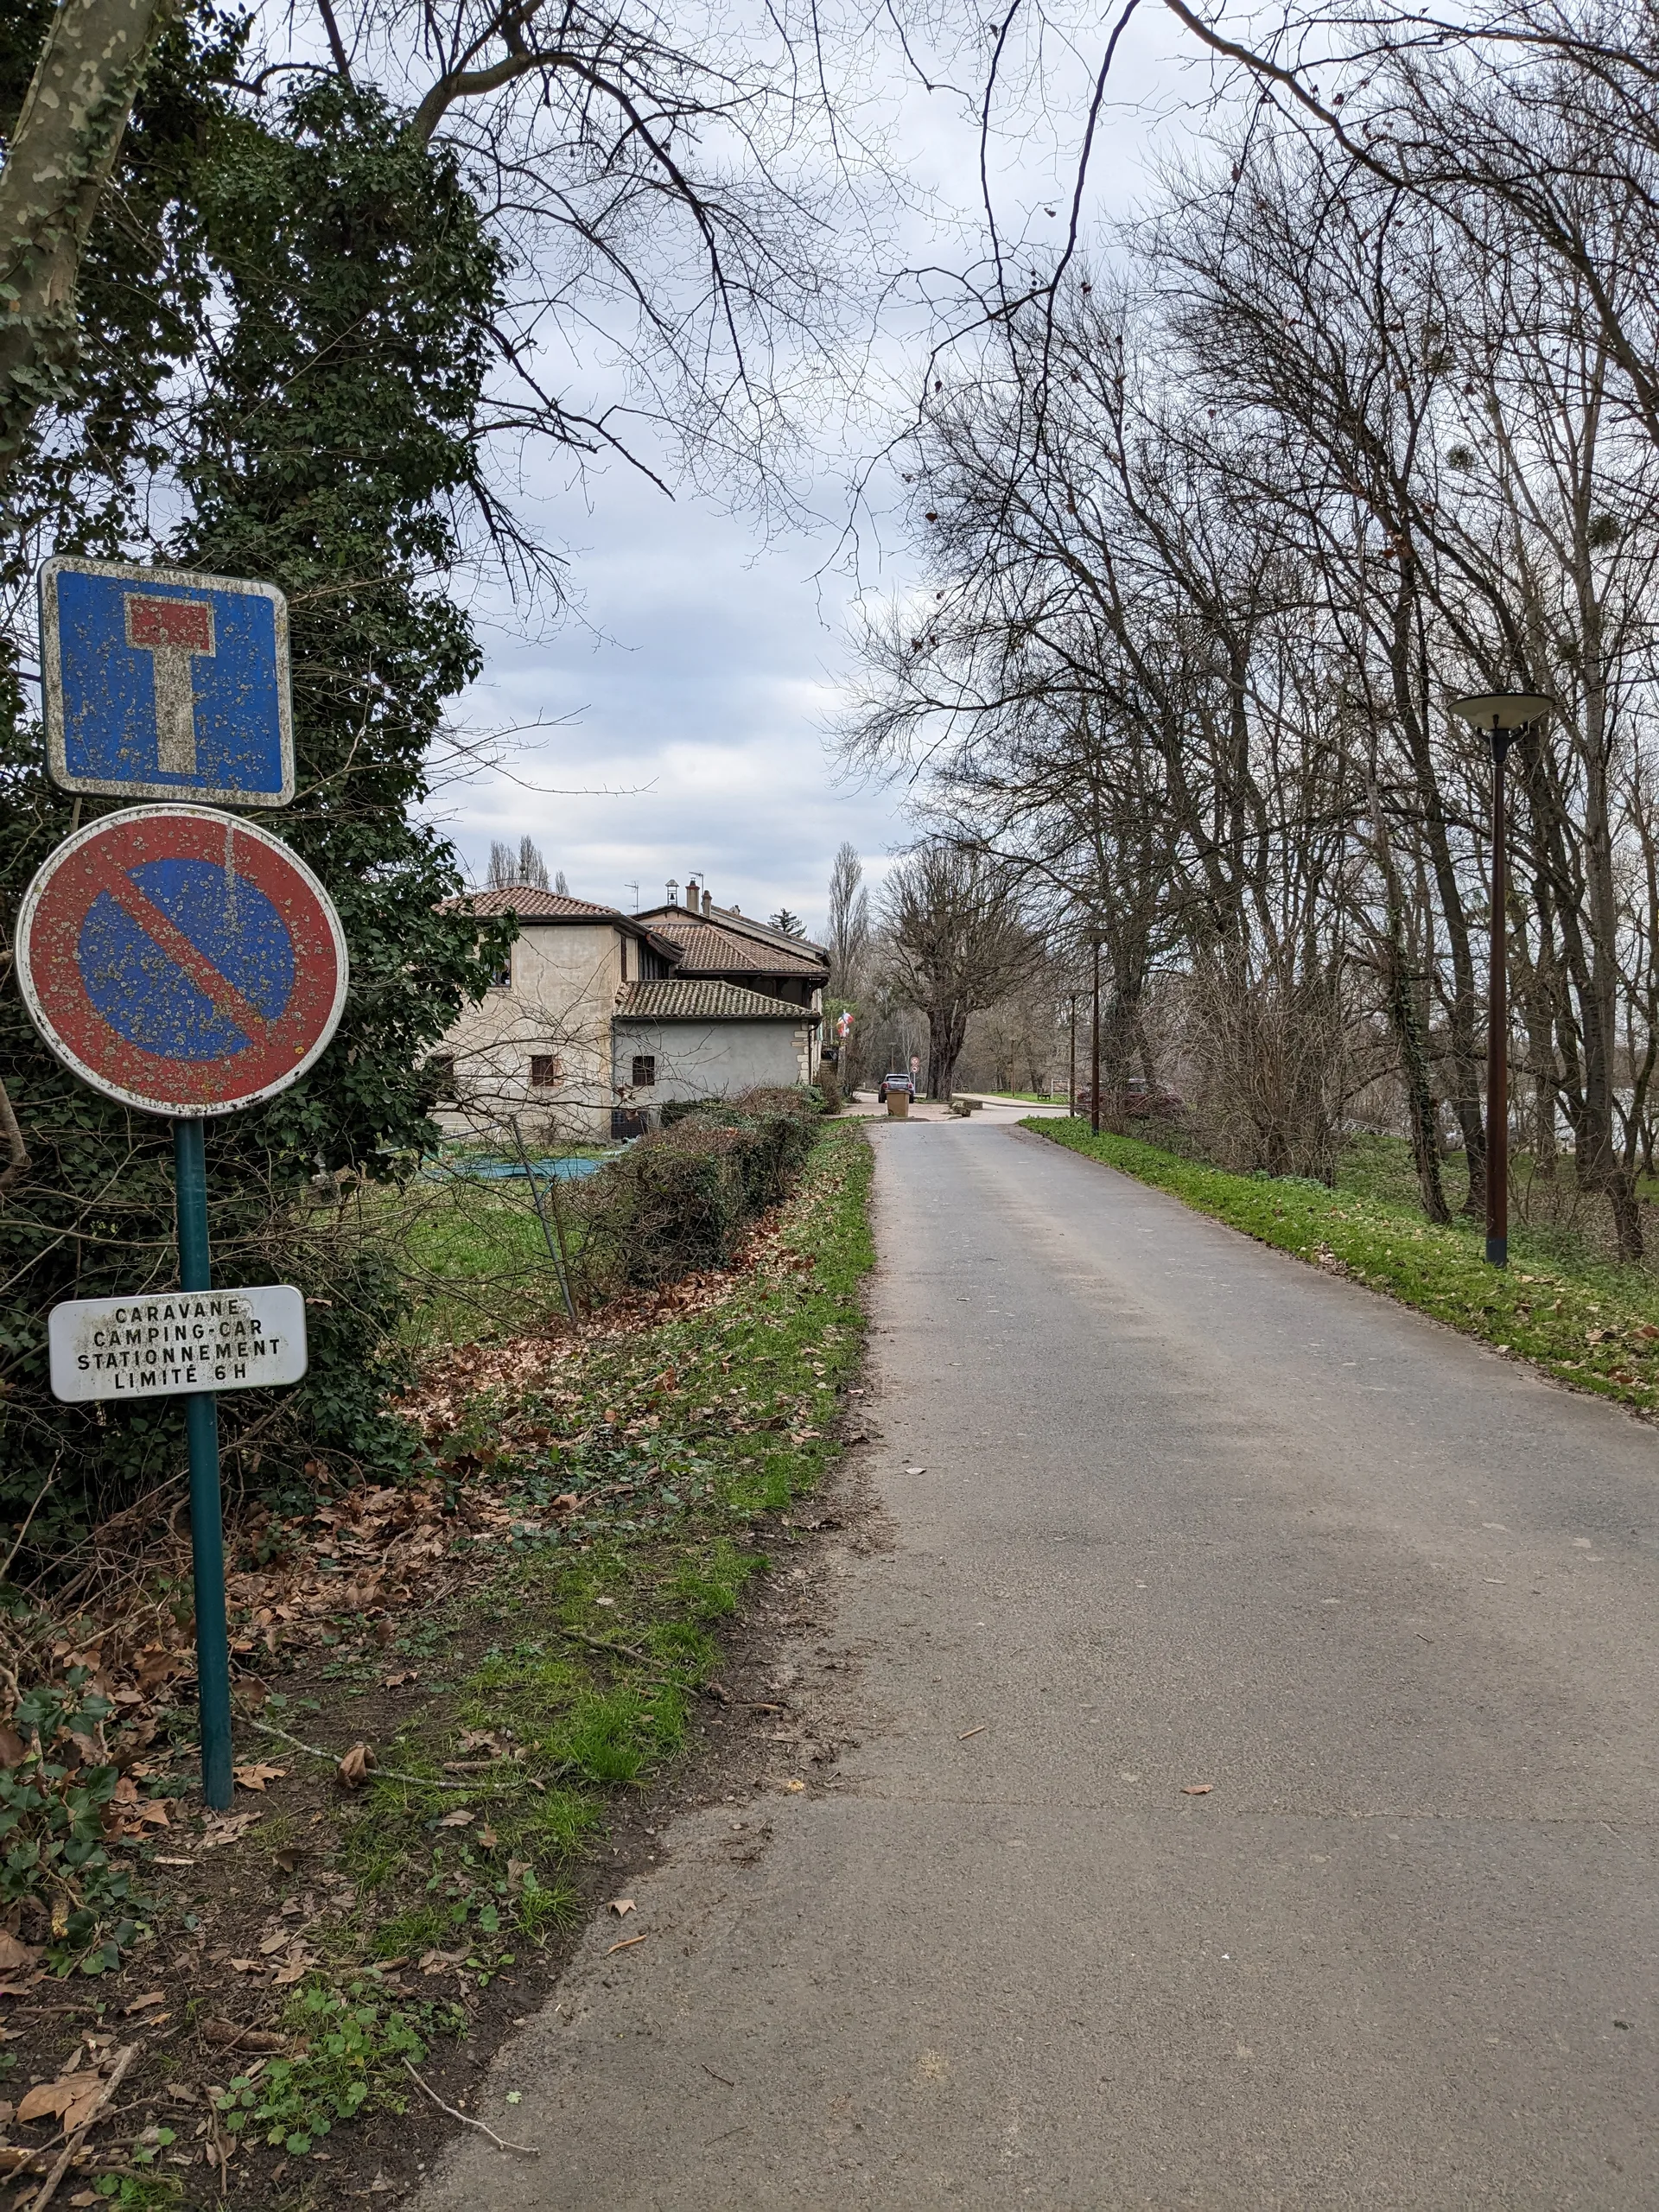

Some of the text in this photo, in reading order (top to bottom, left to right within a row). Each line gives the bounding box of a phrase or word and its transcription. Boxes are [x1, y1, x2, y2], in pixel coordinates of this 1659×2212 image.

[115, 1299, 239, 1324] CARAVANE
[93, 1319, 263, 1347] CAMPING-CAR
[77, 1338, 281, 1370] STATIONNEMENT
[115, 1363, 198, 1389] LIMITÉ
